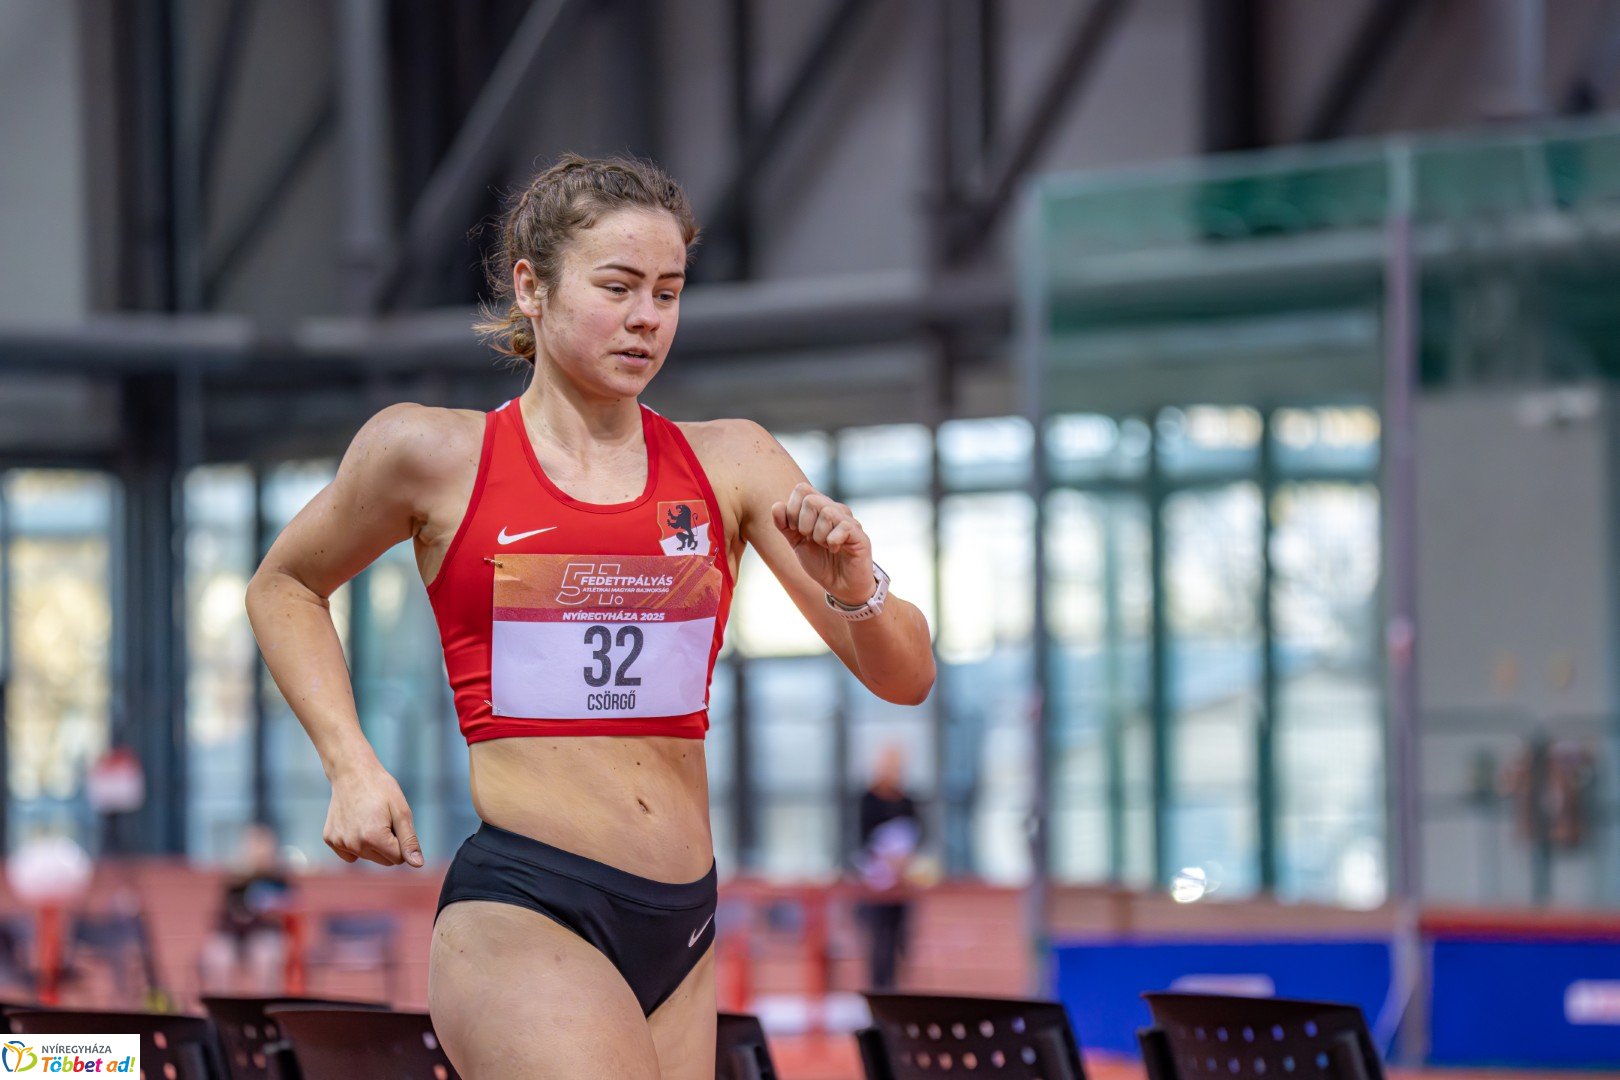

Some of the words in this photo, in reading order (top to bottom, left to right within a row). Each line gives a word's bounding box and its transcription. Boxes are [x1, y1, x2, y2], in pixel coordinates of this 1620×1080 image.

[580, 574, 673, 586] FEDETTPÁLYÁS
[562, 610, 638, 620] NYÍREGYHÁZA
[640, 612, 665, 621] 2025
[583, 625, 644, 687] 32
[587, 690, 636, 711] CSÖRGŐ
